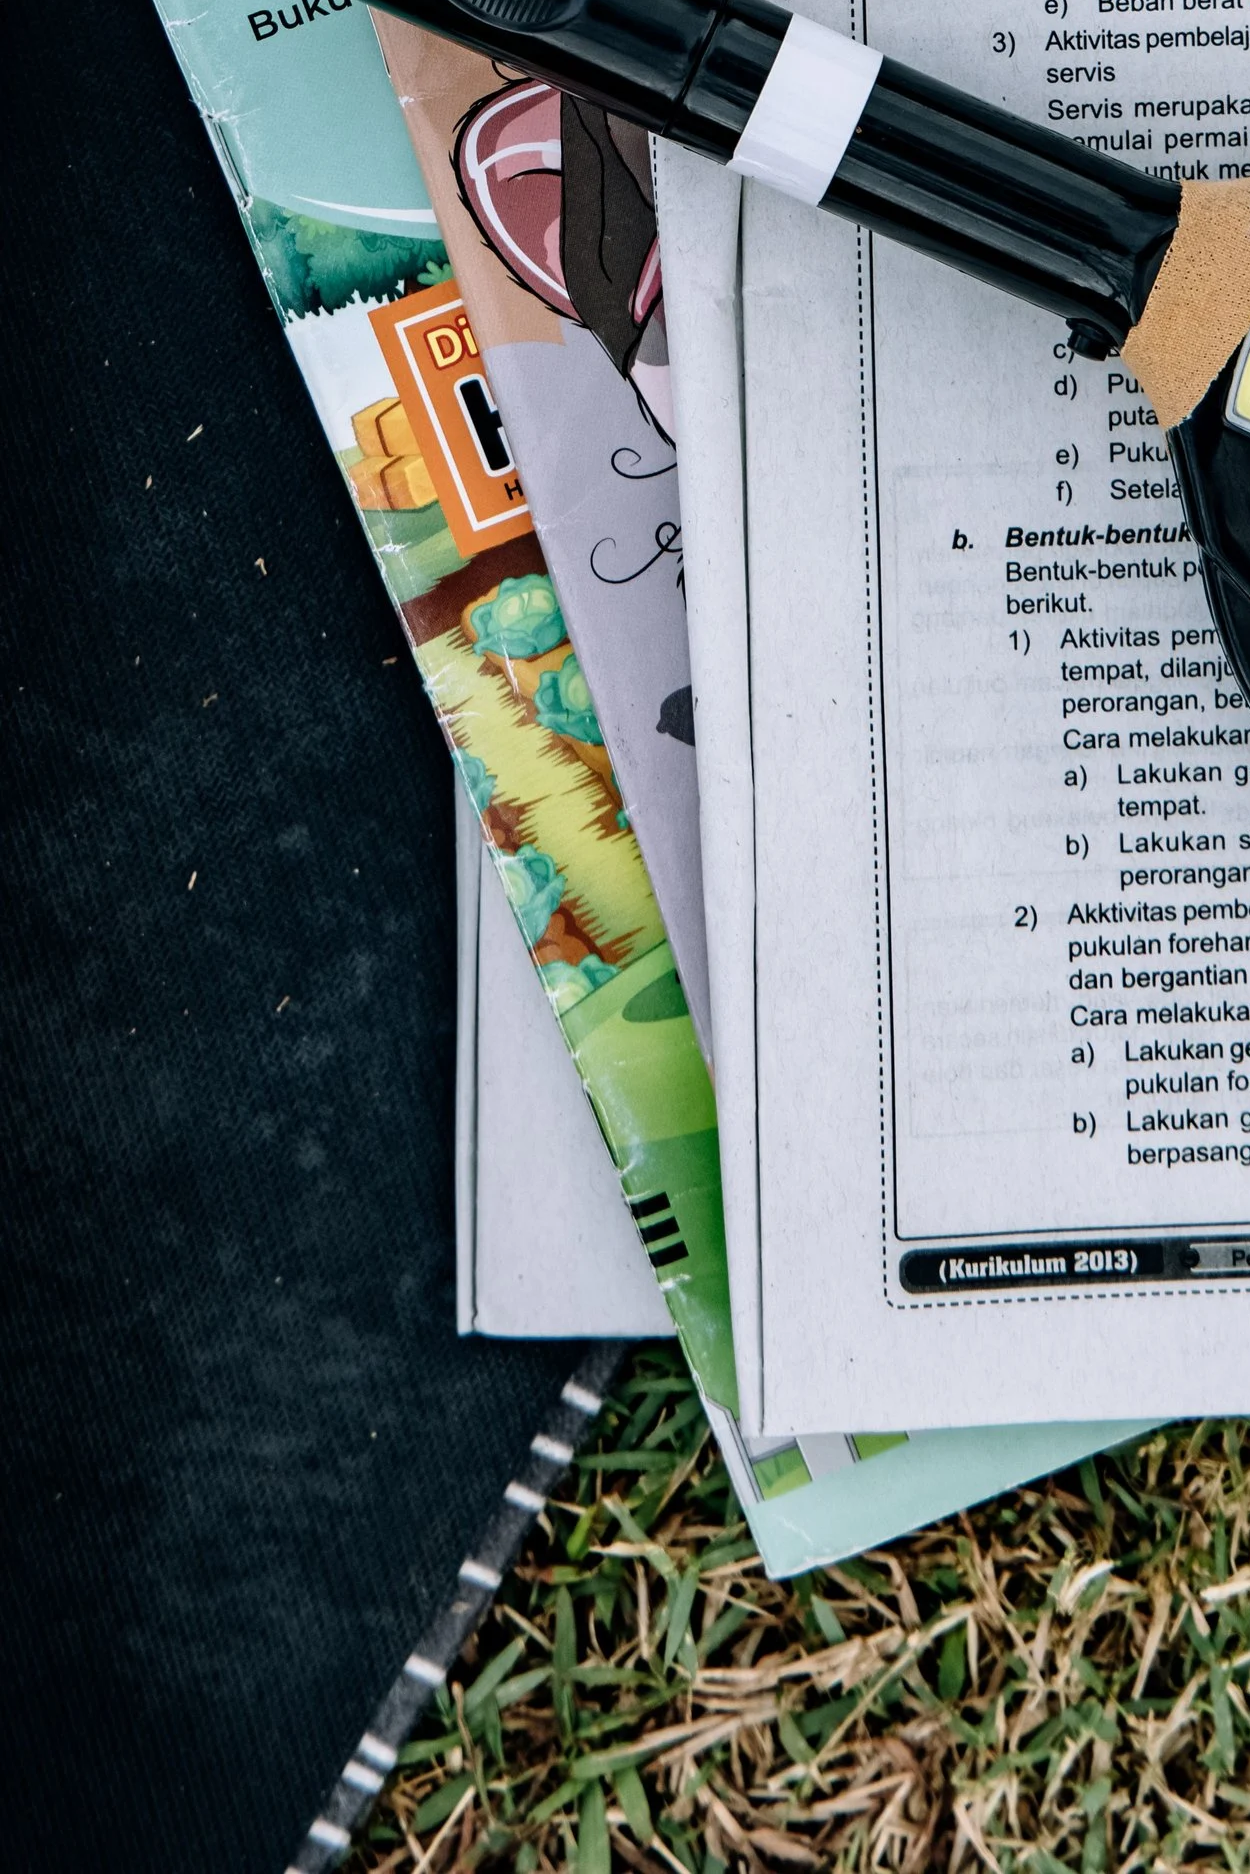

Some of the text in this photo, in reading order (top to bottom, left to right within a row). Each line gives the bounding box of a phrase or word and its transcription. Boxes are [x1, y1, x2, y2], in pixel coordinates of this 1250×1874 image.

[1068, 965, 1248, 993] dan bergantian
[1070, 1004, 1128, 1028] Cara
[1070, 1041, 1095, 1069] a)
[1124, 1038, 1224, 1063] Lakukan
[1125, 1071, 1219, 1101] pukulan
[1072, 1110, 1097, 1139] b)
[1126, 1108, 1229, 1133] Lakukan
[938, 1249, 1138, 1285] (Kurikulum 2013)
